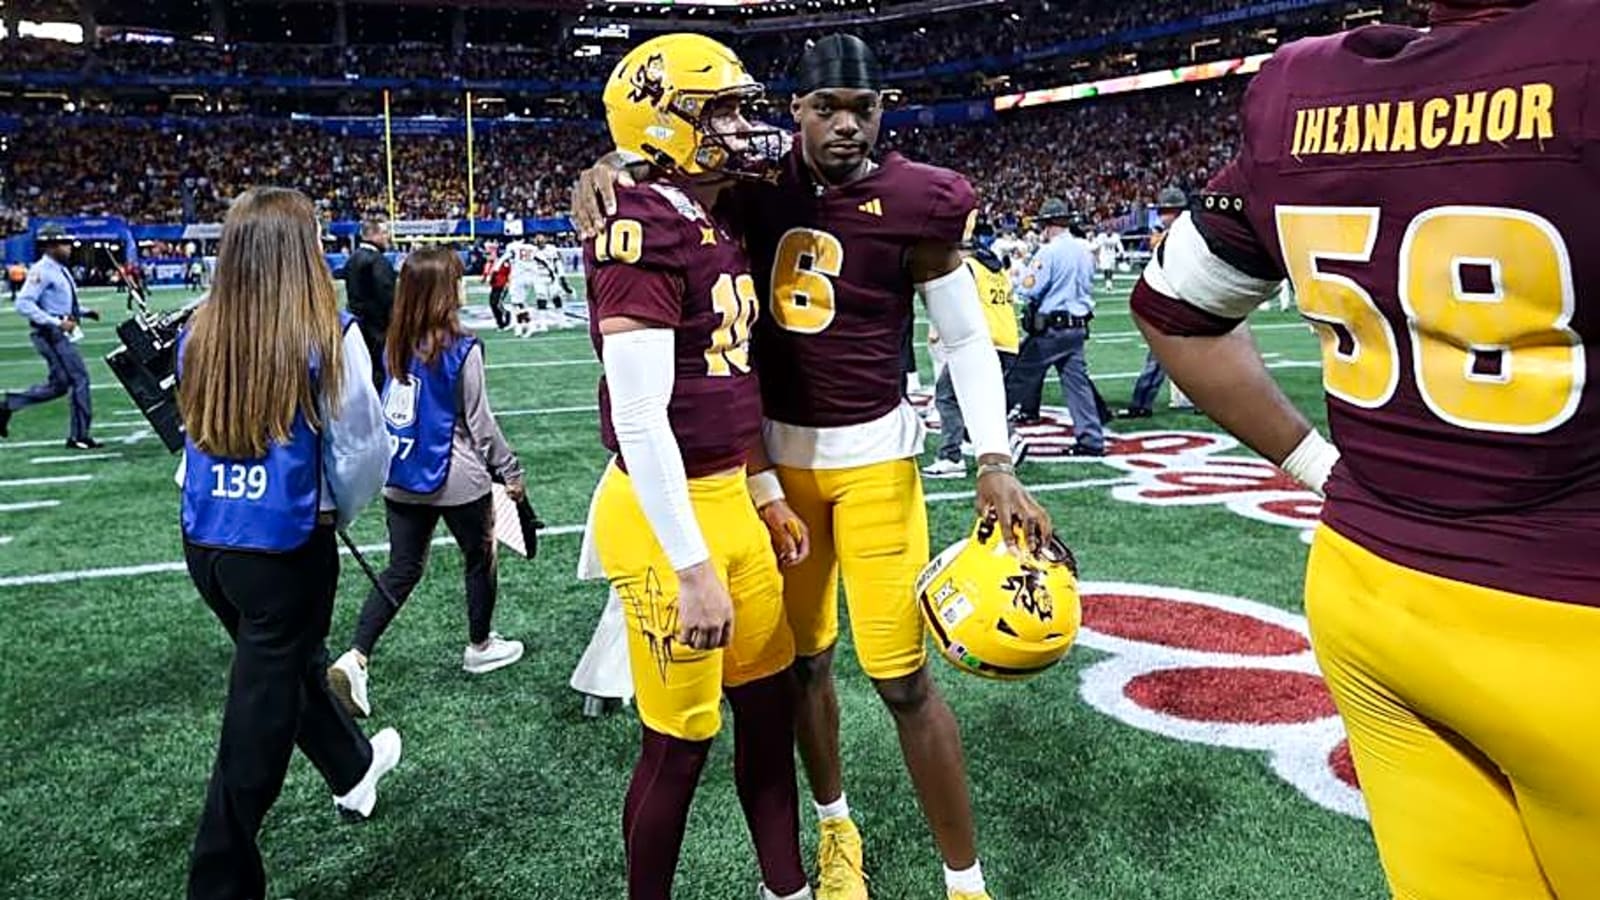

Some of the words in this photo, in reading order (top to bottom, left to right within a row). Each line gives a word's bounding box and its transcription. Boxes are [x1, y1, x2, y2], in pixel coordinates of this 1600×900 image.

[1290, 83, 1554, 156] IHEANACHOR
[594, 219, 643, 264] 10
[769, 226, 844, 334] 6
[704, 273, 760, 376] 10
[1275, 205, 1587, 435] 58
[211, 463, 267, 500] 139
